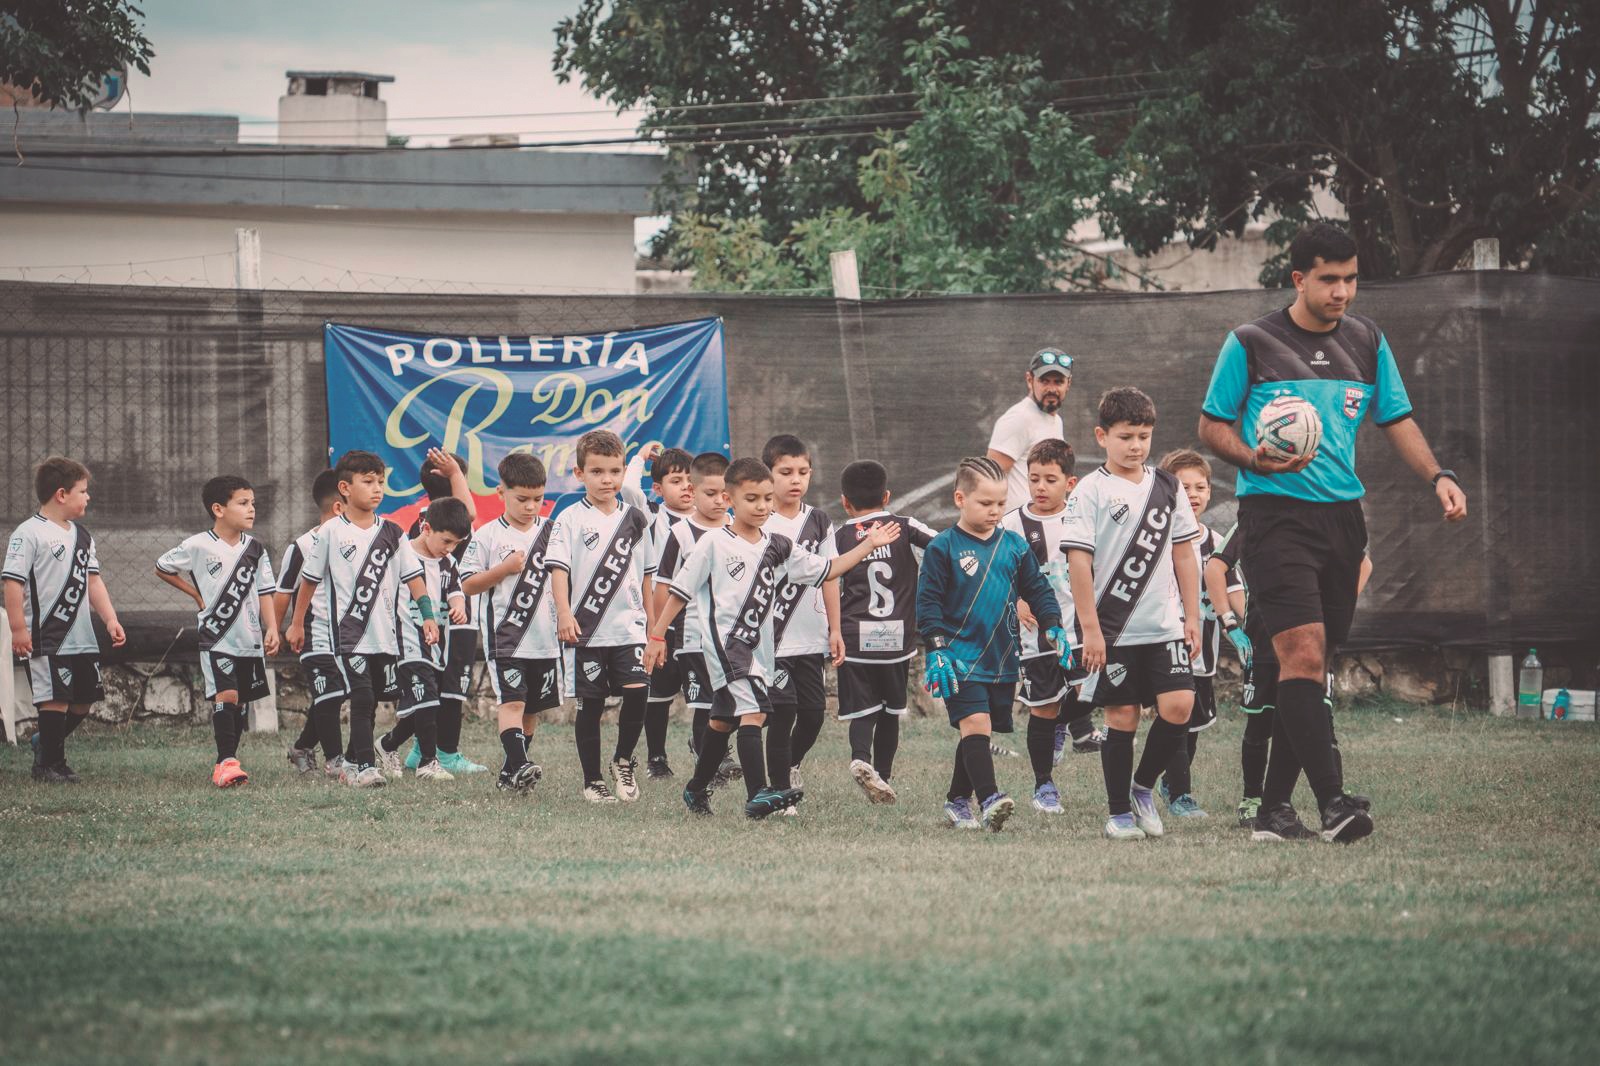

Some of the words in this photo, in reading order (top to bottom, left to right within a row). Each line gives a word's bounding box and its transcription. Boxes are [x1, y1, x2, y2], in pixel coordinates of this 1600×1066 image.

[385, 332, 650, 376] POLLERÍA
[531, 372, 655, 426] Don
[350, 548, 390, 621] F.C.F.C.
[583, 537, 632, 615] F.C.F.C.
[1110, 505, 1171, 603] F.C.F.C.
[206, 566, 254, 635] F.C.F.C.
[507, 552, 545, 628] F.C.F.C
[1166, 642, 1189, 666] 16
